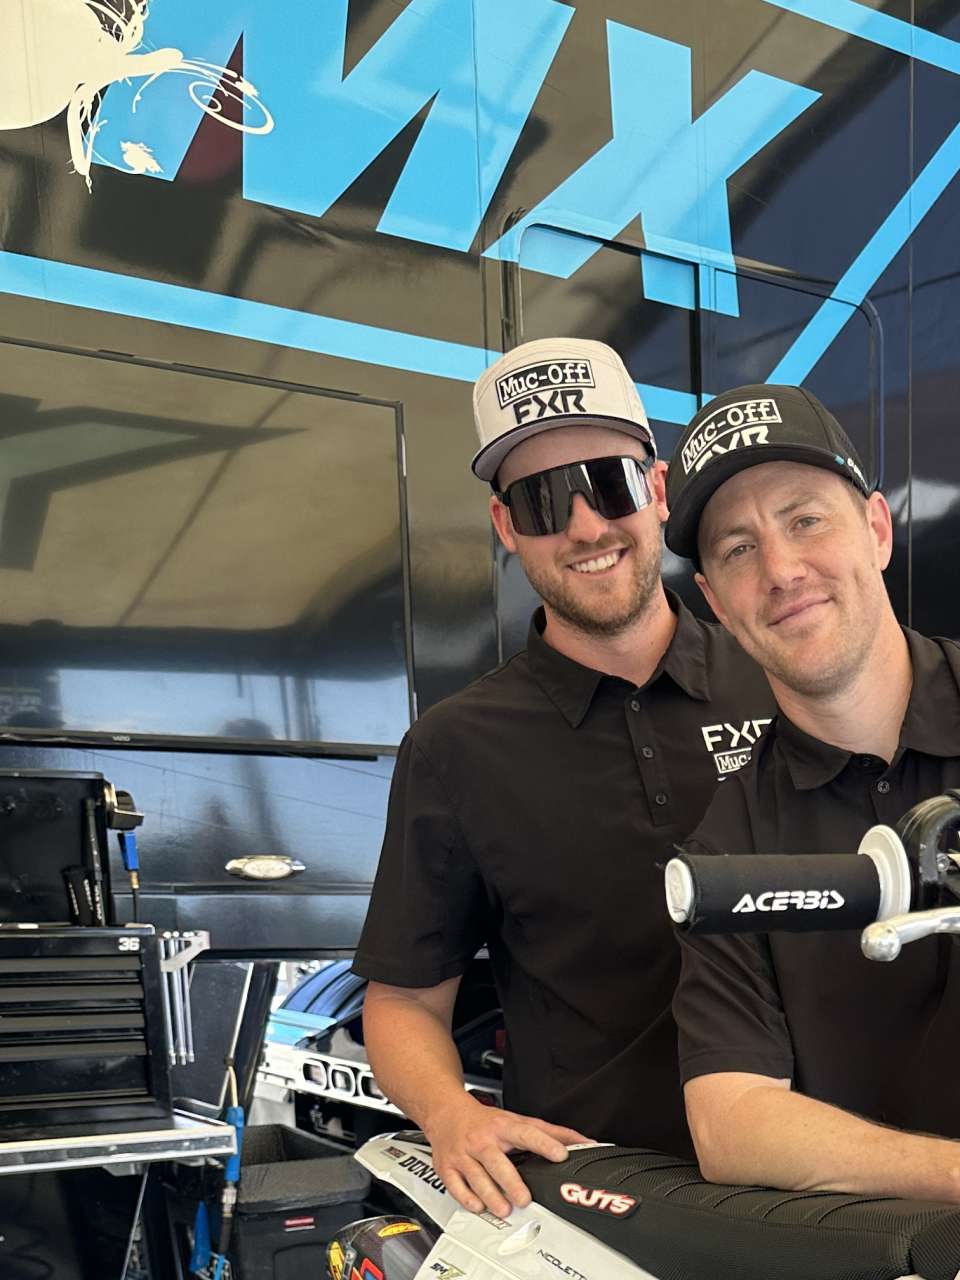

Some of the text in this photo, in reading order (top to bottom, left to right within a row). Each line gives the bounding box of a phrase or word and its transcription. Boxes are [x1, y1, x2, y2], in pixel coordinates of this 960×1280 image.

[500, 361, 591, 401] Muc-Off
[513, 389, 587, 425] FXR
[684, 400, 779, 462] Muc-Off
[732, 890, 845, 914] ACERBIS
[118, 937, 140, 951] 36
[559, 1182, 637, 1218] GUTS
